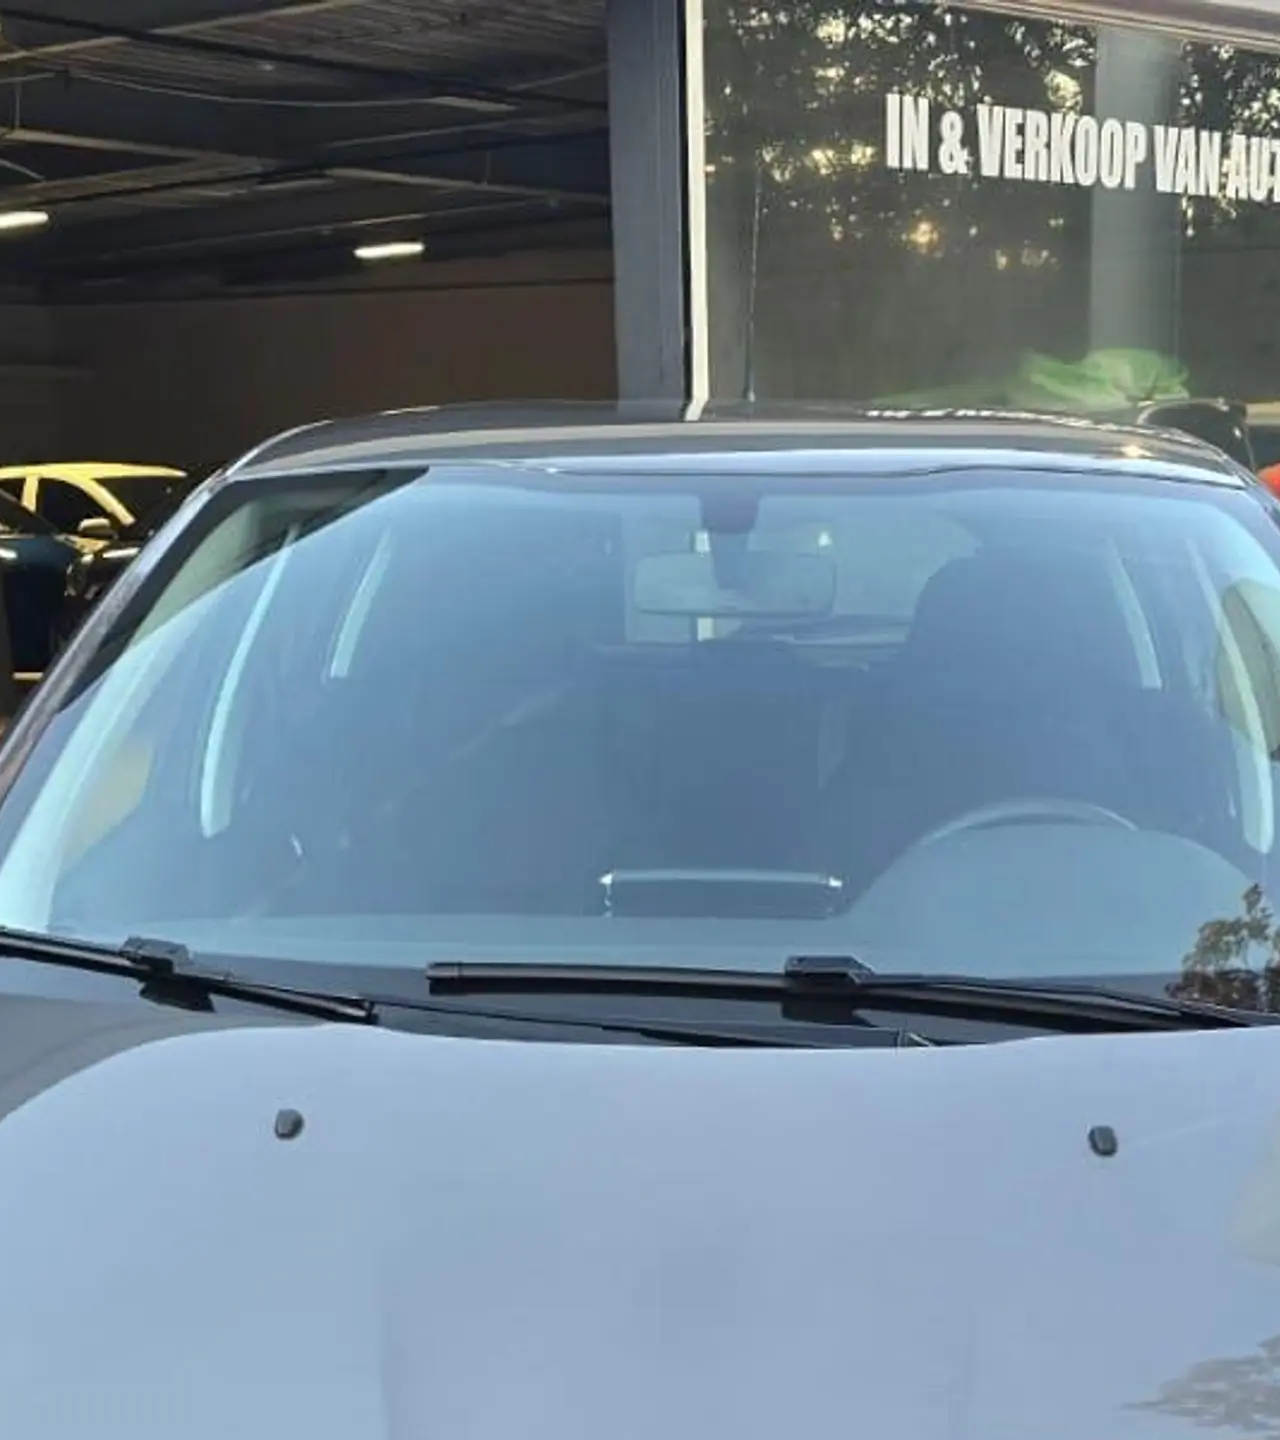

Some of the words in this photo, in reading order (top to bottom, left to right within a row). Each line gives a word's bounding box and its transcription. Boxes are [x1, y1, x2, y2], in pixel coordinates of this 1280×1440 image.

[886, 93, 929, 170] IN
[939, 110, 972, 174] &
[976, 102, 1146, 190] VERKOOP
[1152, 125, 1222, 197] VAN
